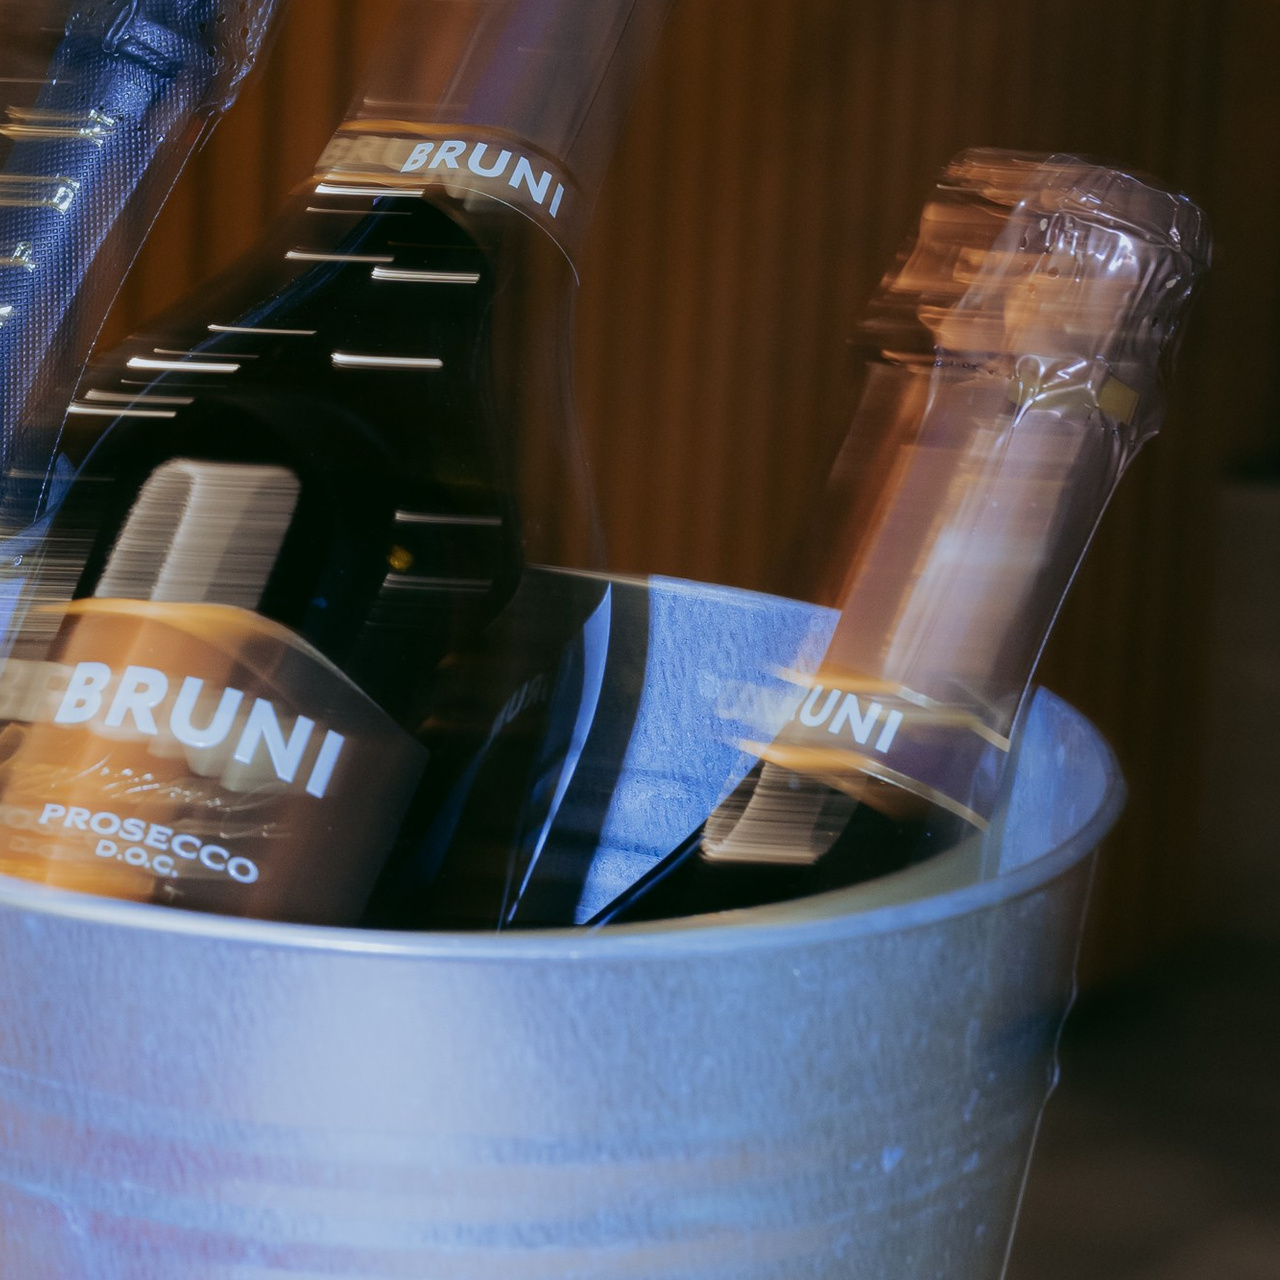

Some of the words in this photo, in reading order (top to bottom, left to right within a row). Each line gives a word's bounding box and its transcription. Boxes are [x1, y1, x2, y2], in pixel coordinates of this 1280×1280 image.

[400, 140, 565, 218] BRUNI
[54, 661, 346, 800] BRUNI
[38, 802, 260, 884] PROSECCO
[95, 839, 179, 879] D.O.C.
